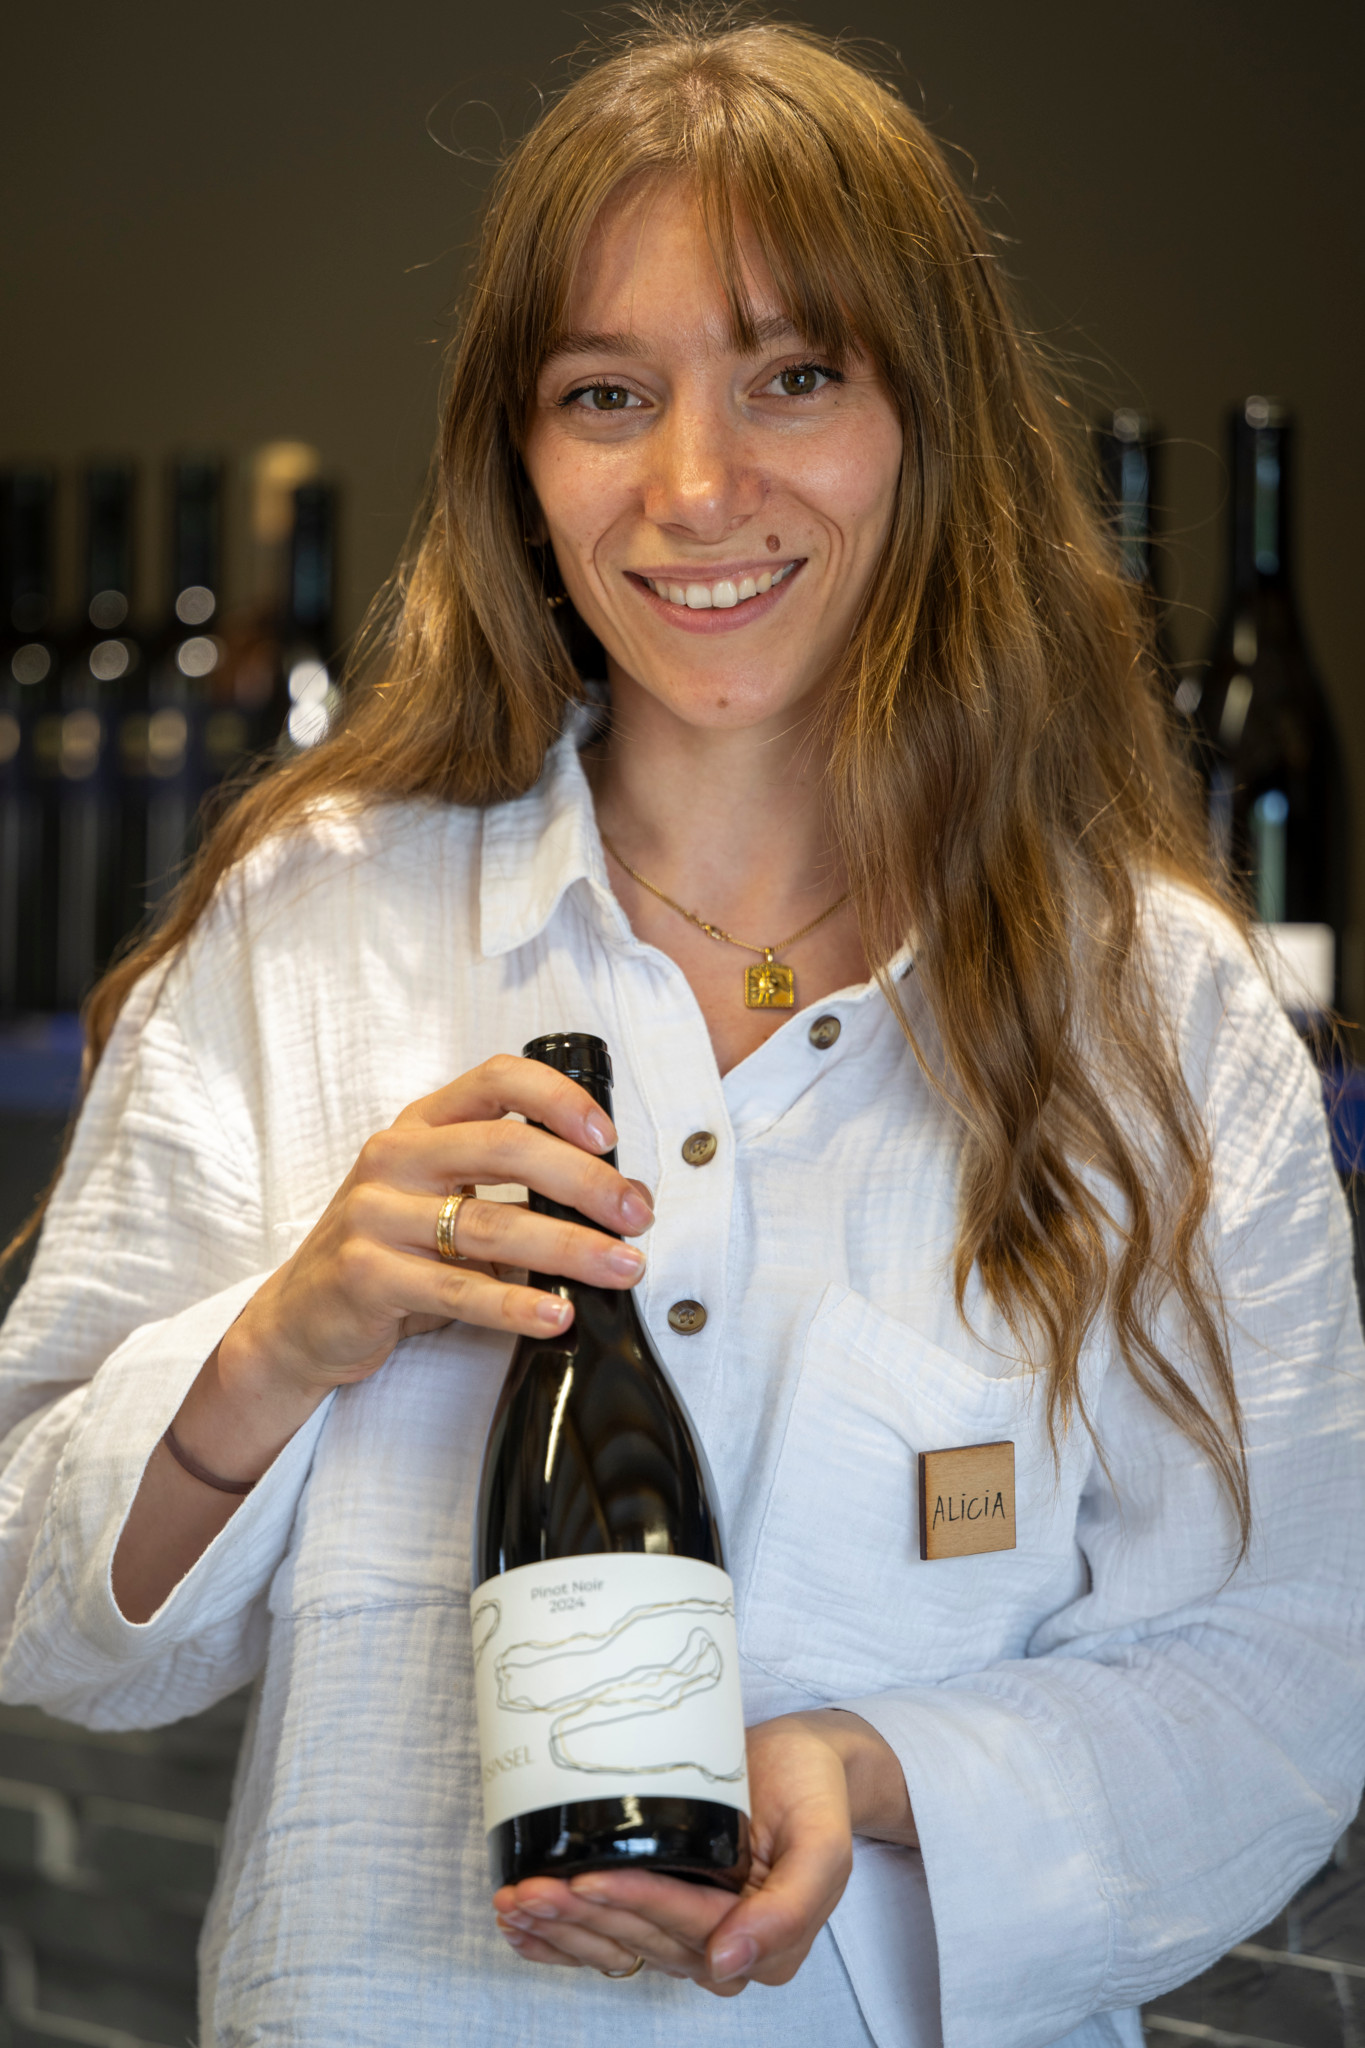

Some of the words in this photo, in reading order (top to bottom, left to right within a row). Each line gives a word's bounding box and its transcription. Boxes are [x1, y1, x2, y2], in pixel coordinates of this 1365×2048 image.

[530, 1582, 567, 1600] Pinot
[571, 1577, 604, 1593] Noir
[549, 1596, 585, 1614] 2024
